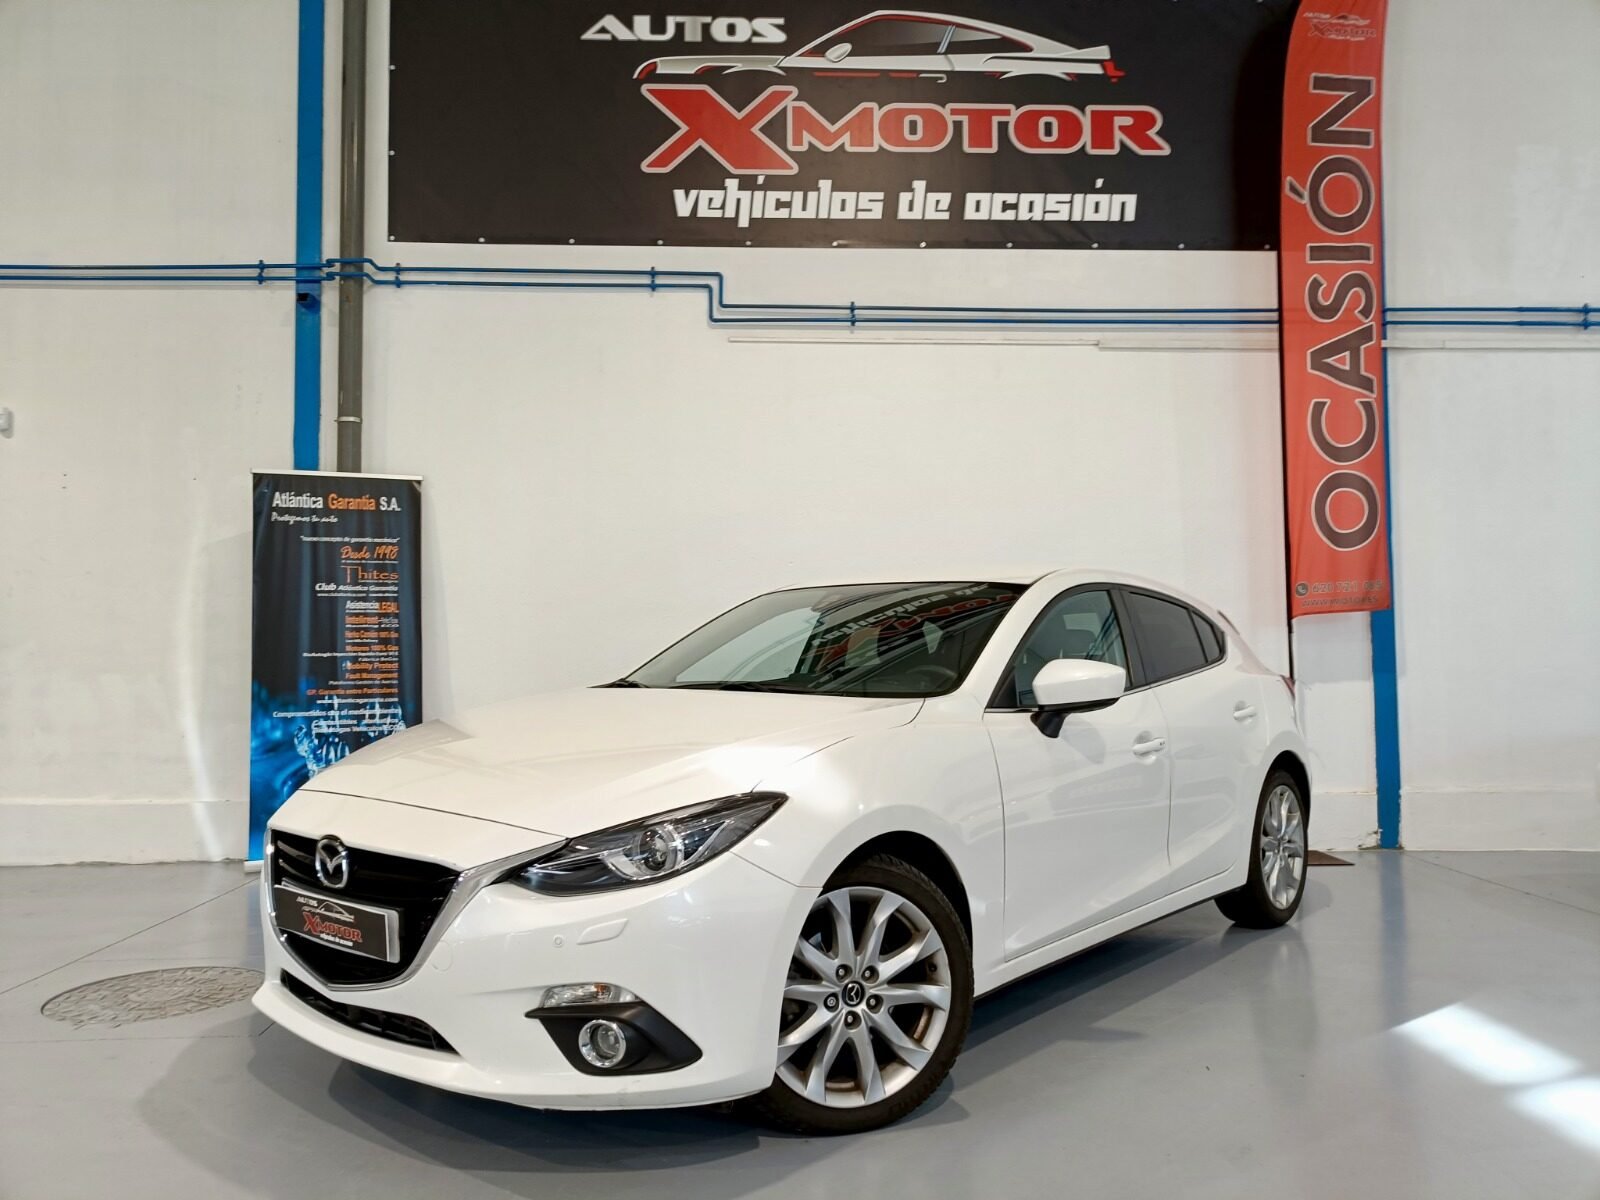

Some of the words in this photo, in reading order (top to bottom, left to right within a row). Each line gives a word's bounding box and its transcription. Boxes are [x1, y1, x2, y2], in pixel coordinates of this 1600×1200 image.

[580, 14, 787, 42] AUTOS
[640, 83, 1171, 174] XMOTOR
[897, 179, 951, 221] de
[964, 178, 1137, 222] ocasión
[1285, 73, 1379, 551] OCASIÓN
[272, 491, 323, 508] Atlántica
[328, 493, 376, 510] Garantía
[379, 496, 401, 511] S.A.
[341, 545, 370, 559] Desde
[374, 545, 399, 560] 1998
